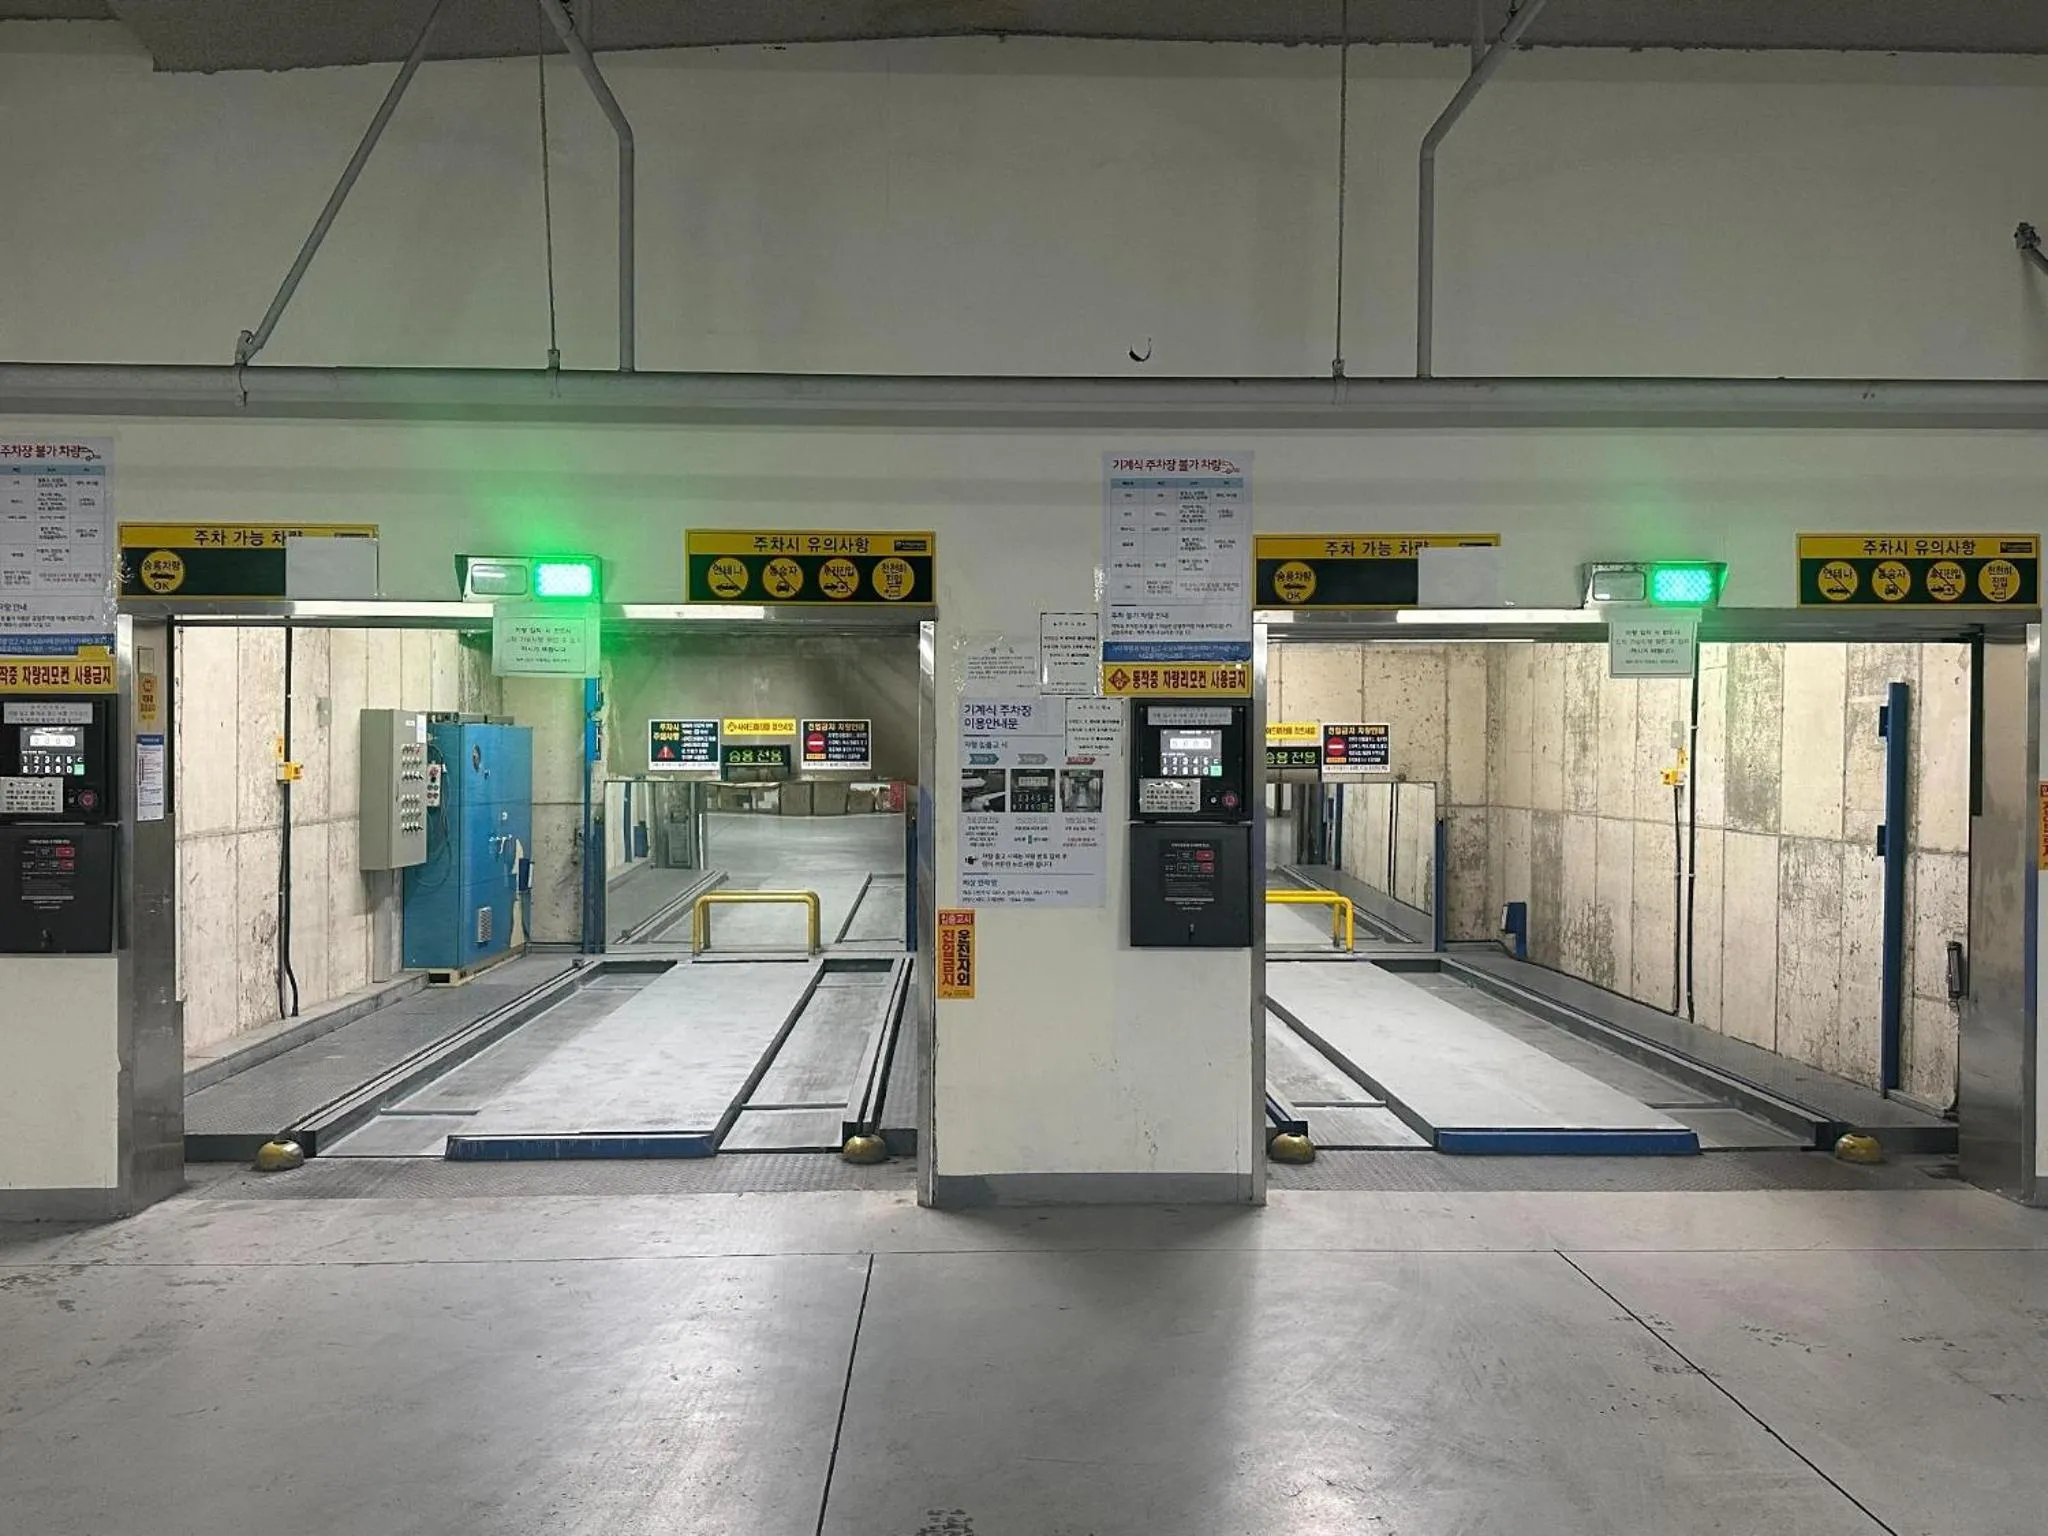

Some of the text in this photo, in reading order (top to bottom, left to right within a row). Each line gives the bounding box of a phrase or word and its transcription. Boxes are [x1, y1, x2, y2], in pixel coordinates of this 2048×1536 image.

[1, 444, 80, 458] 주차장 불가 차량
[1113, 459, 1221, 472] 기계식 주차장 불가 차량
[194, 530, 225, 546] 주차
[234, 530, 264, 546] 가능
[754, 536, 869, 553] 주차시 유의사항
[1325, 541, 1355, 556] 주차
[1362, 541, 1392, 557] 가능
[1864, 540, 1976, 556] 주차시 유의사항
[154, 582, 169, 591] OK
[1286, 592, 1300, 600] OK
[23, 666, 69, 685] 차량리모컨
[74, 666, 111, 685] 사용금지
[1132, 670, 1158, 689] 동작중
[1210, 670, 1245, 689] 사용금지
[964, 704, 1032, 717] 기계식 주차장
[964, 718, 1019, 730] 이용안내문
[942, 929, 954, 986] 진입금지
